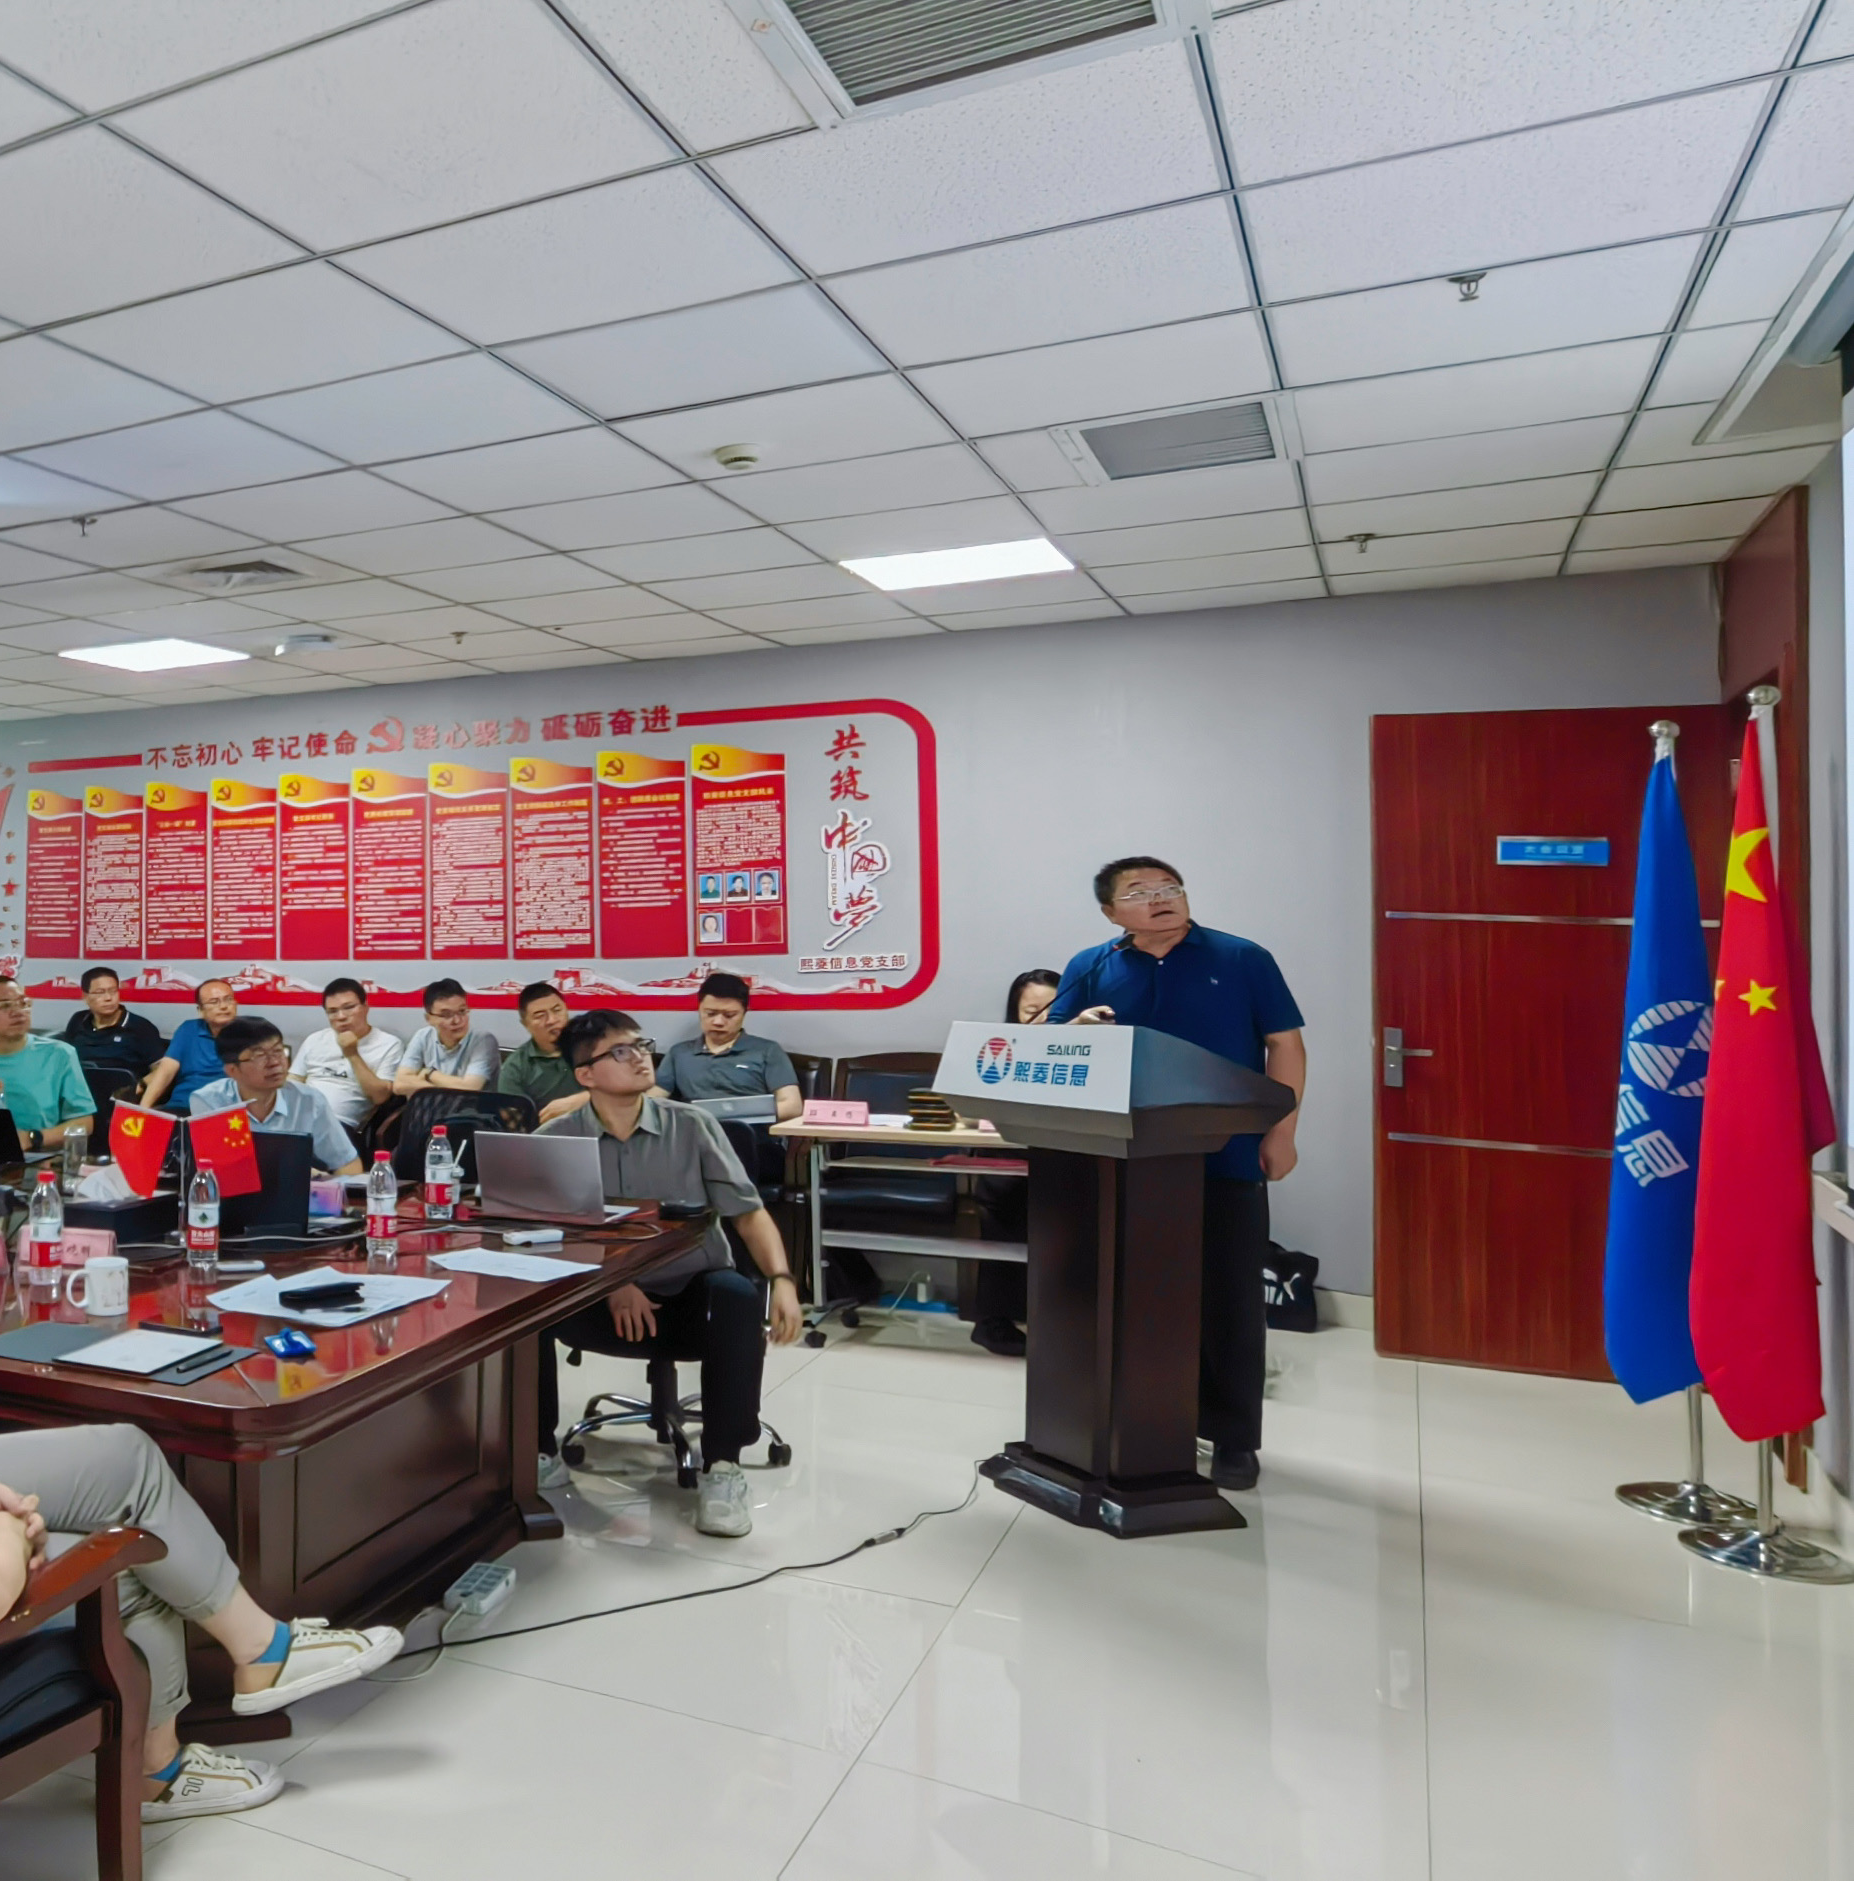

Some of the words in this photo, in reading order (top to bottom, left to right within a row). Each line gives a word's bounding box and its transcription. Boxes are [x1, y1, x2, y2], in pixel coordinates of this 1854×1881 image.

[146, 741, 243, 770] 不忘初心
[251, 729, 358, 762] 牢记使命
[412, 717, 531, 750] 凝心聚力
[541, 705, 671, 742] 砥砺奋进
[800, 955, 905, 970] 熙菱信息党支部
[1047, 1044, 1091, 1056] SAILING
[1012, 1061, 1089, 1086] 熙菱信息
